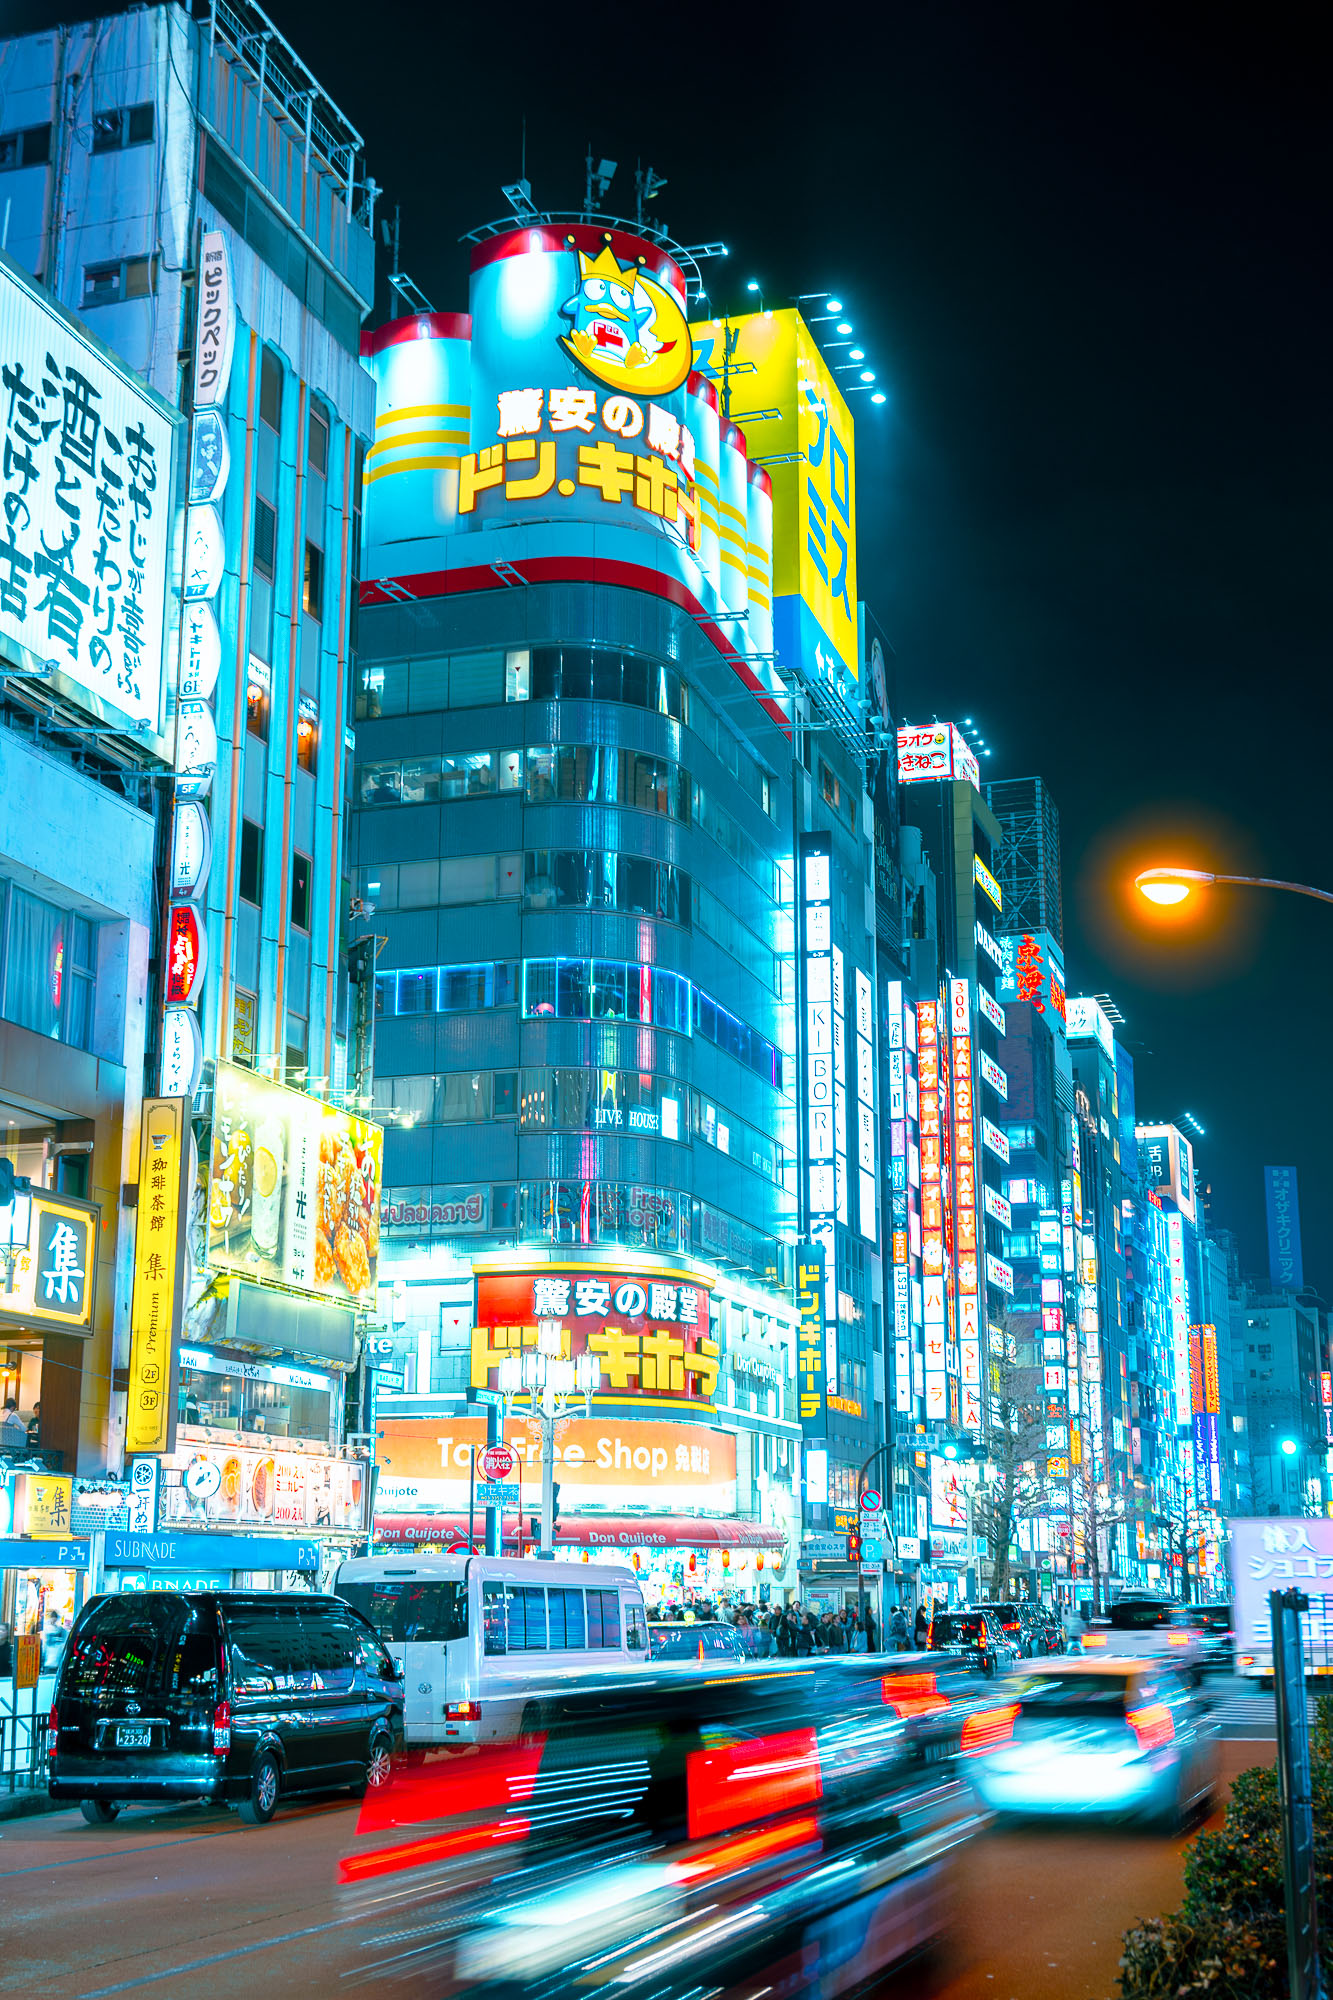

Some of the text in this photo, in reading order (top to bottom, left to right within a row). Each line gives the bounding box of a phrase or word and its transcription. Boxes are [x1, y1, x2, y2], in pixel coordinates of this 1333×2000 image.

[33, 350, 102, 661] 酒と肴
[88, 424, 124, 676] こだわりの
[191, 585, 204, 595] 7F
[897, 752, 946, 772] きねこ
[181, 783, 195, 794] 5F
[955, 983, 966, 1018] 300
[595, 1108, 623, 1124] LIVE
[150, 1158, 168, 1233] 珈琲茶館
[1275, 1188, 1294, 1284] オザキクリニック
[41, 1221, 85, 1304] 集
[144, 1252, 165, 1281] 集
[897, 1270, 908, 1297] ZEST
[533, 1278, 699, 1324] 驚安の殿堂
[145, 1291, 160, 1355] Premium
[799, 1264, 822, 1418] ドン・キホーテ
[144, 1368, 157, 1380] 2F
[963, 1304, 978, 1424] PASELA
[142, 1394, 156, 1407] 3F
[485, 1456, 511, 1470] 消火栓
[597, 1437, 669, 1478] Shop
[674, 1444, 711, 1475] 免税店
[49, 1486, 68, 1527] 集
[404, 1527, 455, 1542] Quijote
[588, 1531, 667, 1547] Don Quijote
[114, 1540, 177, 1562] SUBNADE
